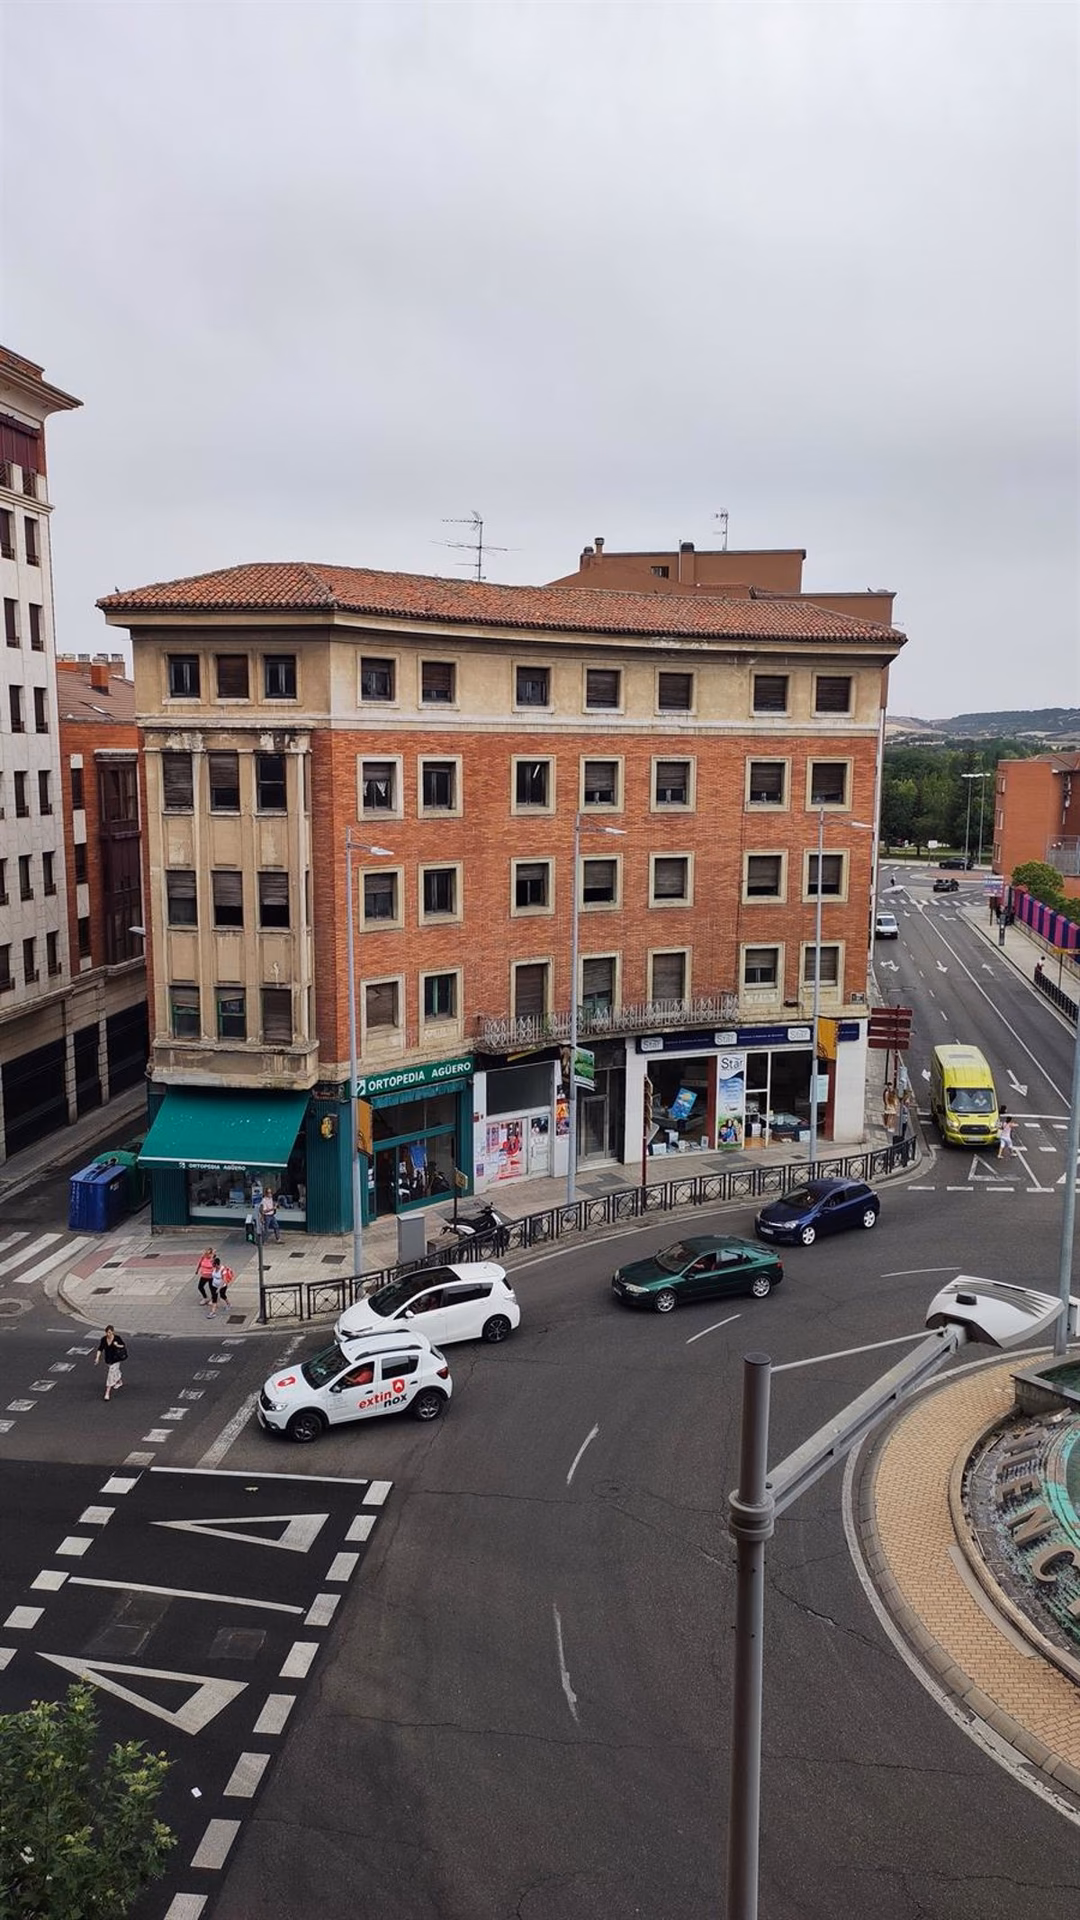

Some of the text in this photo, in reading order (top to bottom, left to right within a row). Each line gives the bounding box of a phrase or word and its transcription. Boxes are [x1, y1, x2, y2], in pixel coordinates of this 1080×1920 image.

[721, 1058, 743, 1069] Star
[368, 1062, 471, 1091] ORTOPEDIA AGÜERO
[359, 1392, 392, 1409] extin
[384, 1394, 407, 1408] nox
